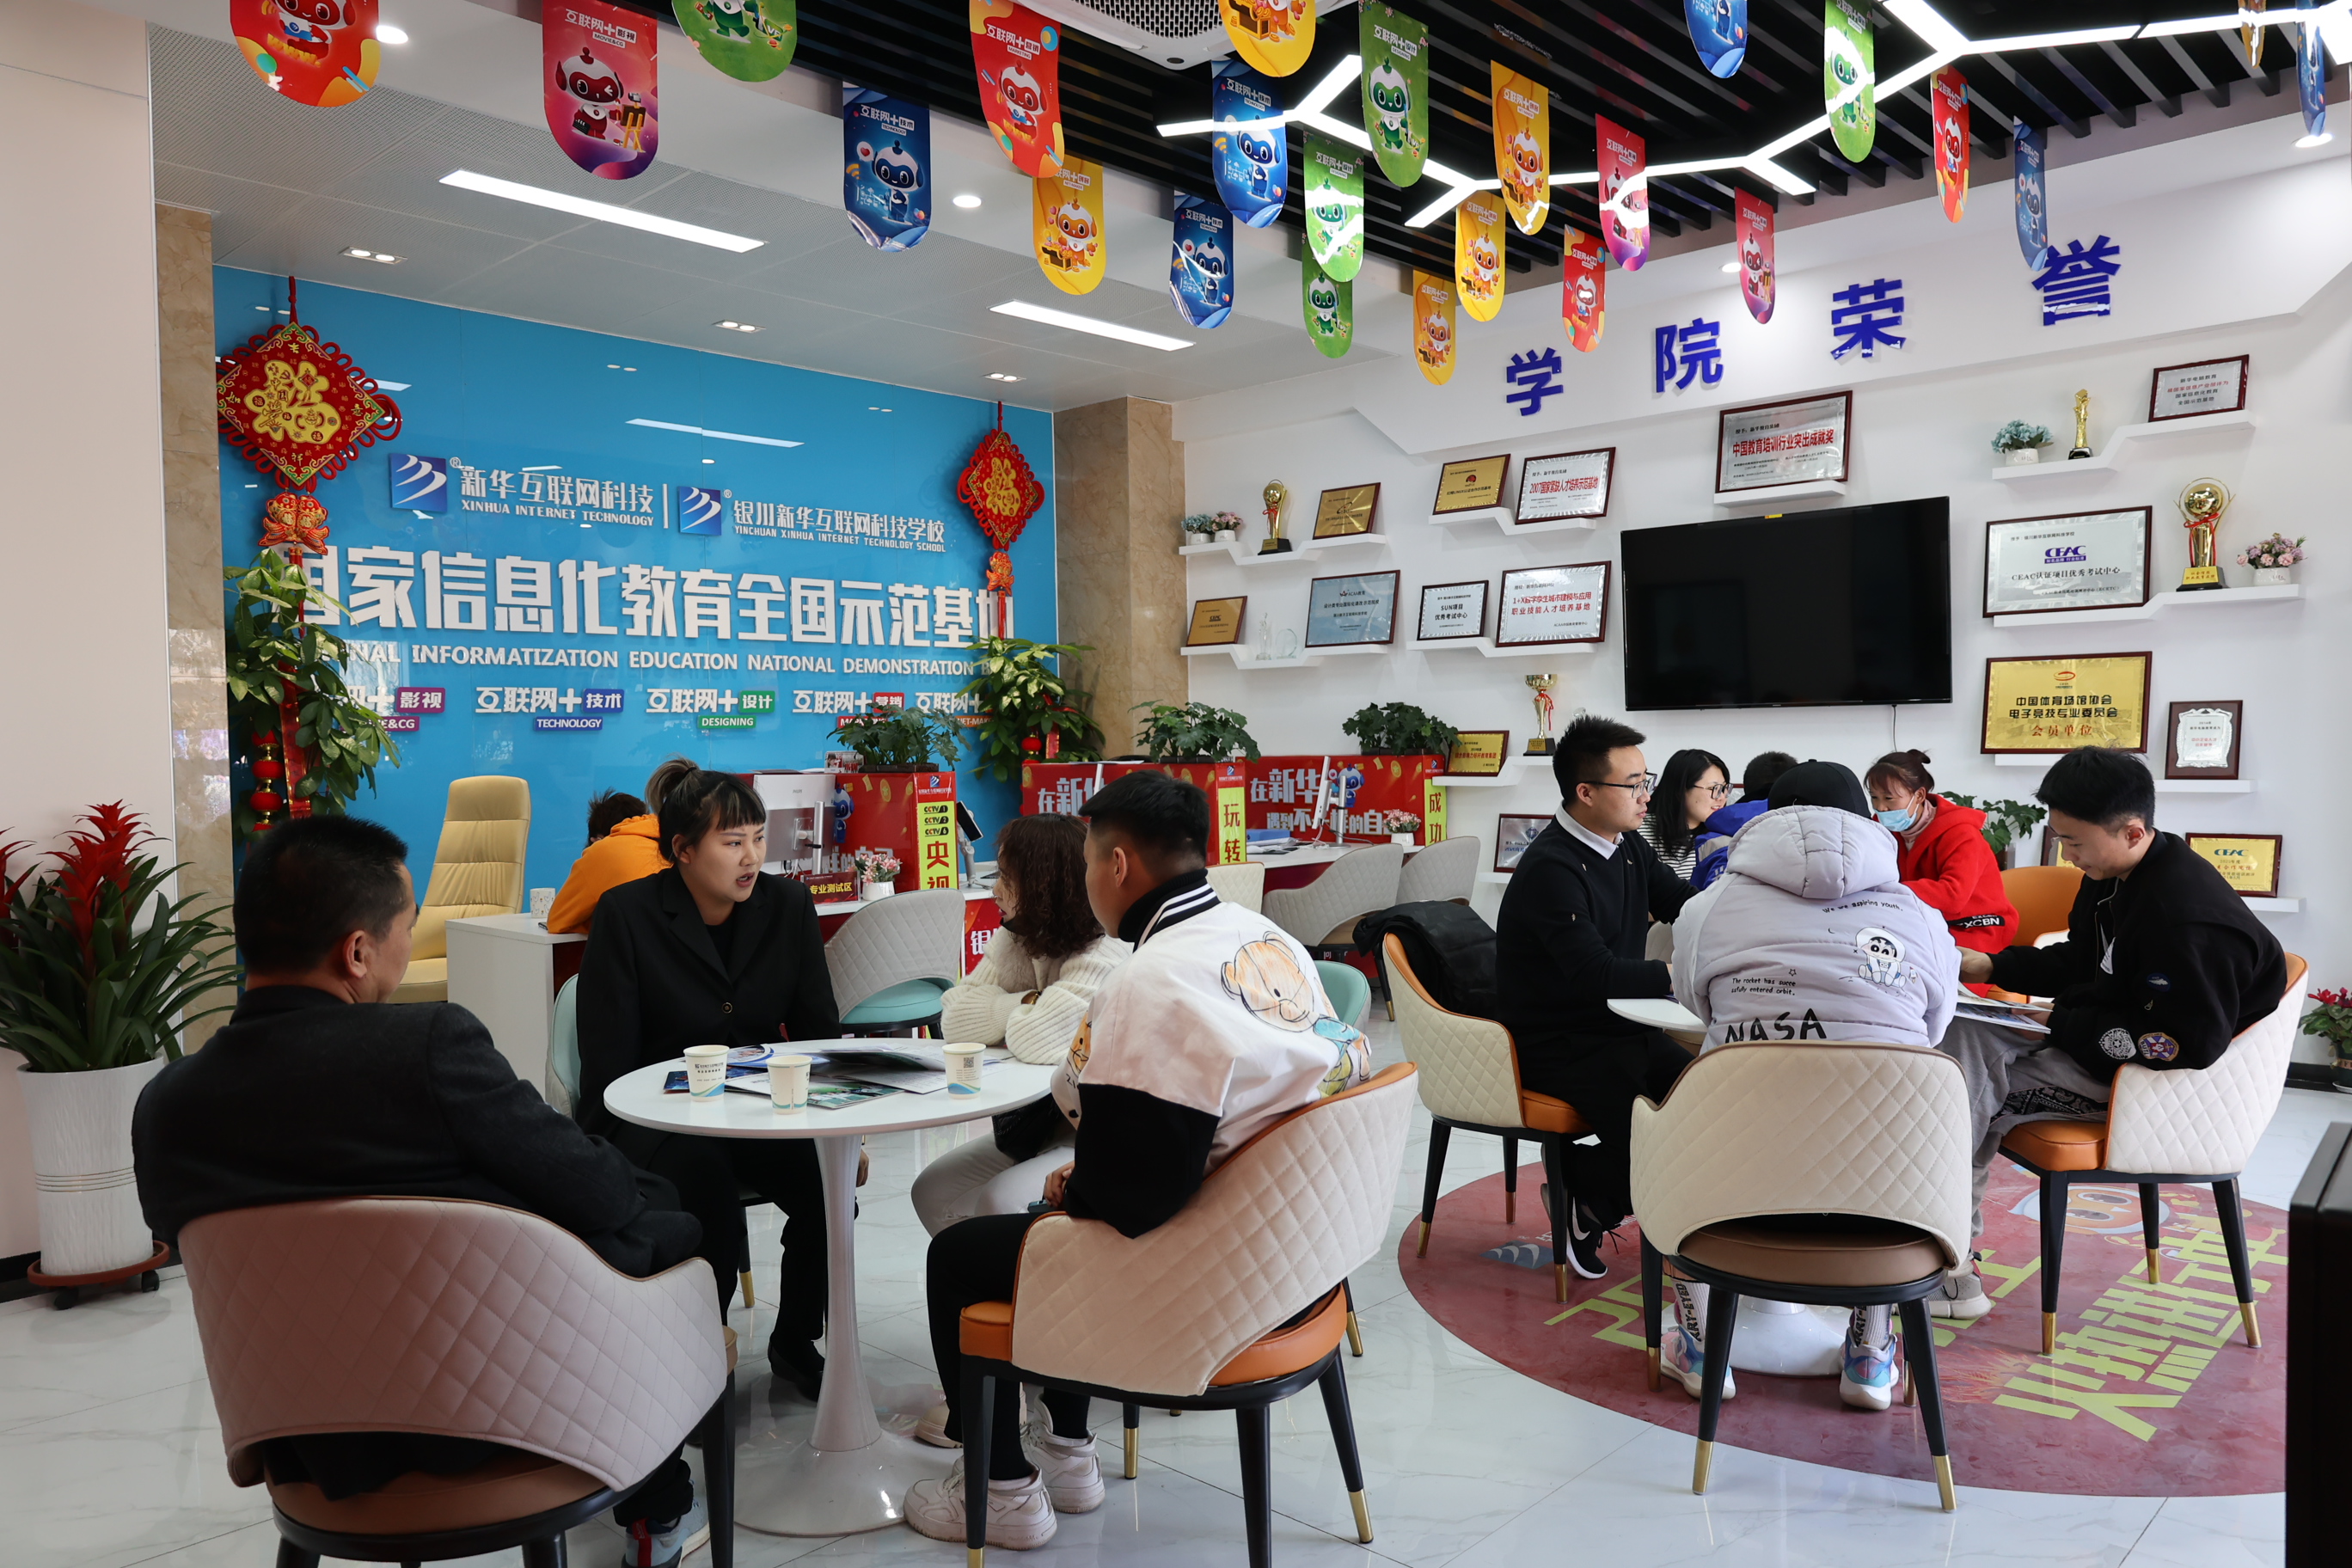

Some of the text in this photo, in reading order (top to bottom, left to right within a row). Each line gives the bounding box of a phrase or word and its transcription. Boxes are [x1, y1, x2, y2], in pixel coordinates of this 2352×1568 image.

[565, 9, 636, 43] 互联网+影视
[594, 34, 624, 46] MOVIE&CG
[987, 24, 1040, 54] 互联网+营销
[1374, 25, 1417, 57] 互联网+设计
[1008, 46, 1031, 58] MARKETING
[861, 104, 915, 131] 互联网+技术
[1055, 168, 1090, 186] 联网+创客
[1505, 235, 2121, 416] 学院荣誉
[1733, 429, 1834, 457] 中国教育培训行业突出成就奖
[461, 467, 653, 513] 新华互联网科技
[462, 500, 653, 526] XINHUA INTERNET TECHNOLOGY
[733, 500, 945, 542] 银川新华互联网科技学校
[735, 525, 946, 552] YINCHUAN XINHUA INTERNET TECHNOLOGY SCHOOL
[2044, 546, 2086, 558] CEAC
[1435, 611, 1468, 621] 优秀考试中心
[1511, 603, 1591, 616] 职业技能人才培养基地
[413, 645, 618, 668] INFORMATIZATION
[629, 651, 738, 671] EDUCATION
[748, 654, 835, 673] NATIONAL
[843, 658, 974, 676] DEMONSTRATION
[475, 687, 623, 714] 互联网+技术
[646, 689, 774, 714] 互联网+设计
[2009, 707, 2117, 719] 电子竞技专业委员会
[2016, 695, 2112, 706] 中国体育场馆协会
[536, 719, 602, 729] TECHNOLOGY
[701, 717, 754, 727] DESIGNING
[2032, 725, 2092, 737] 会员单位
[1223, 803, 1240, 862] 玩转
[810, 882, 853, 894] 专业测试区
[1957, 917, 2000, 928] XCBN
[1724, 1008, 1827, 1044] NASA
[1992, 1229, 2290, 1443] 火热进行中
